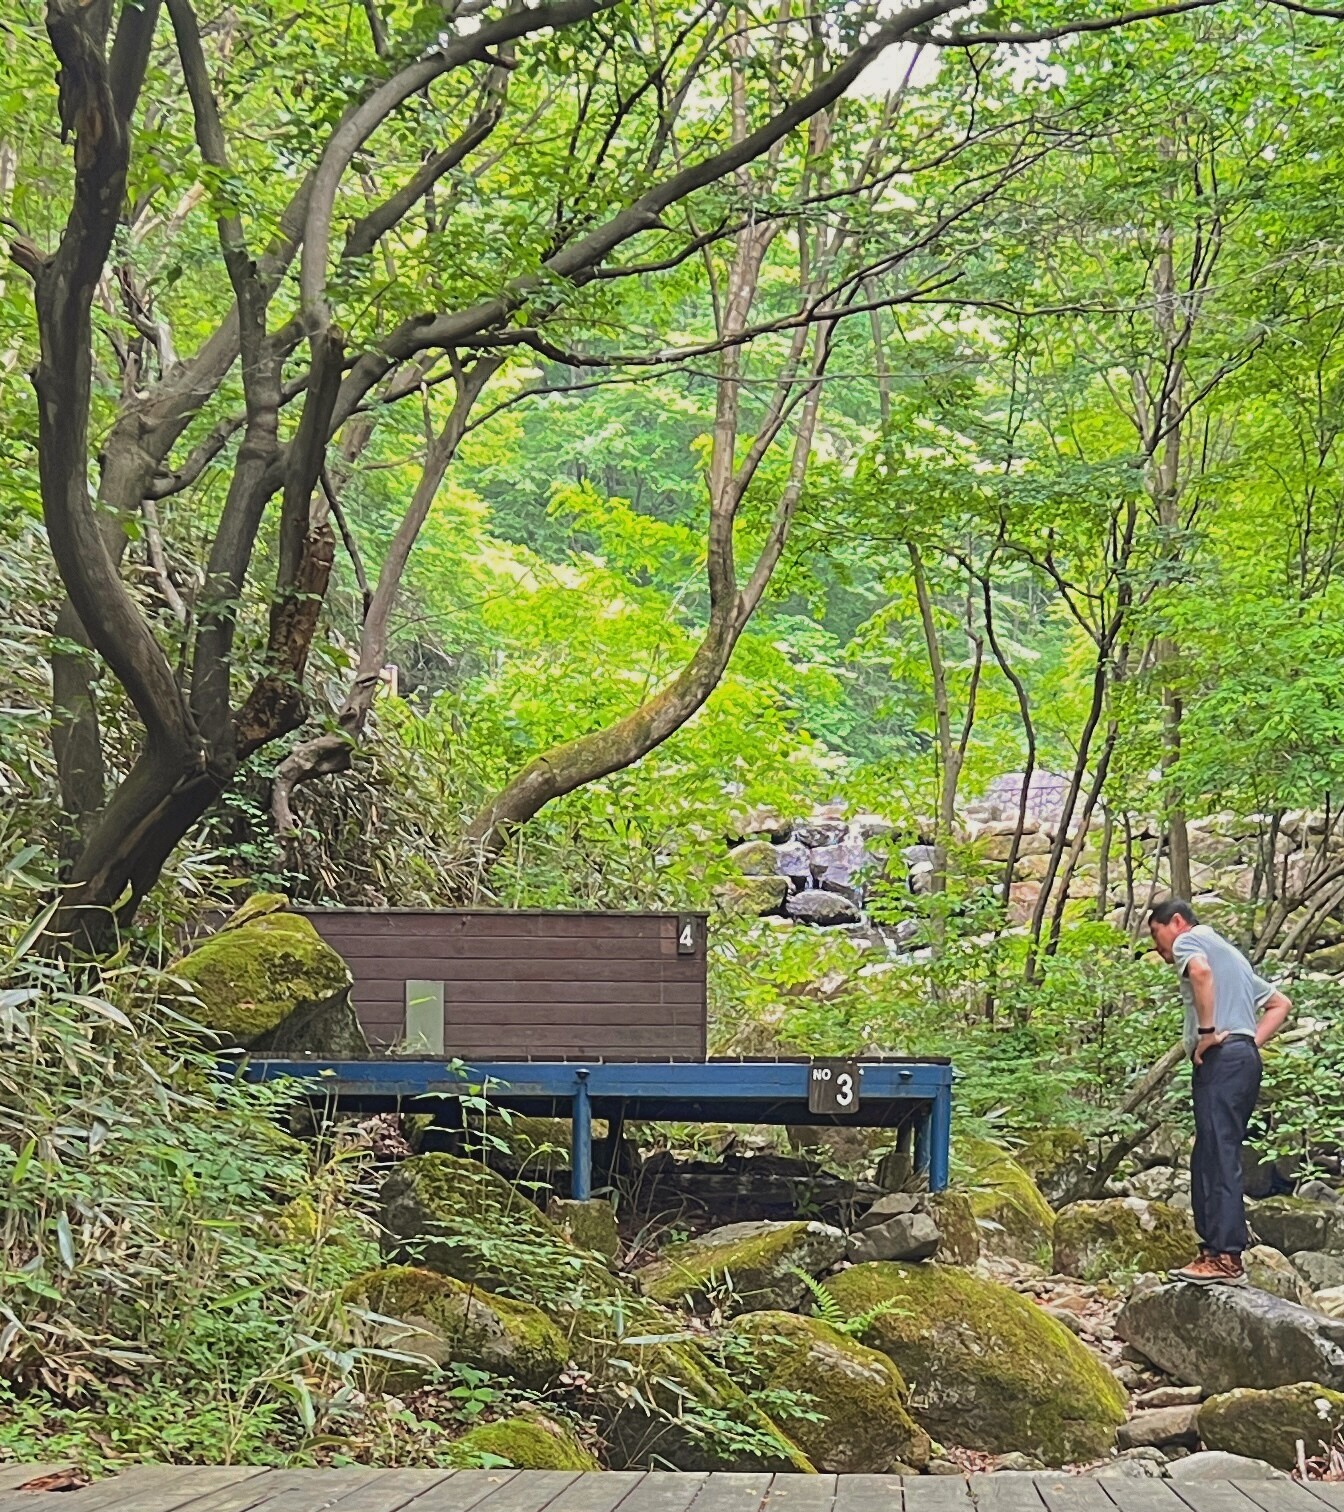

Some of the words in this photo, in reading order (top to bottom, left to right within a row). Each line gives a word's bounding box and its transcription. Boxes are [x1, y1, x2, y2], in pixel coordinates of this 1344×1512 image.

[679, 924, 693, 947] 4
[812, 1068, 832, 1081] NO
[836, 1073, 854, 1106] 3
